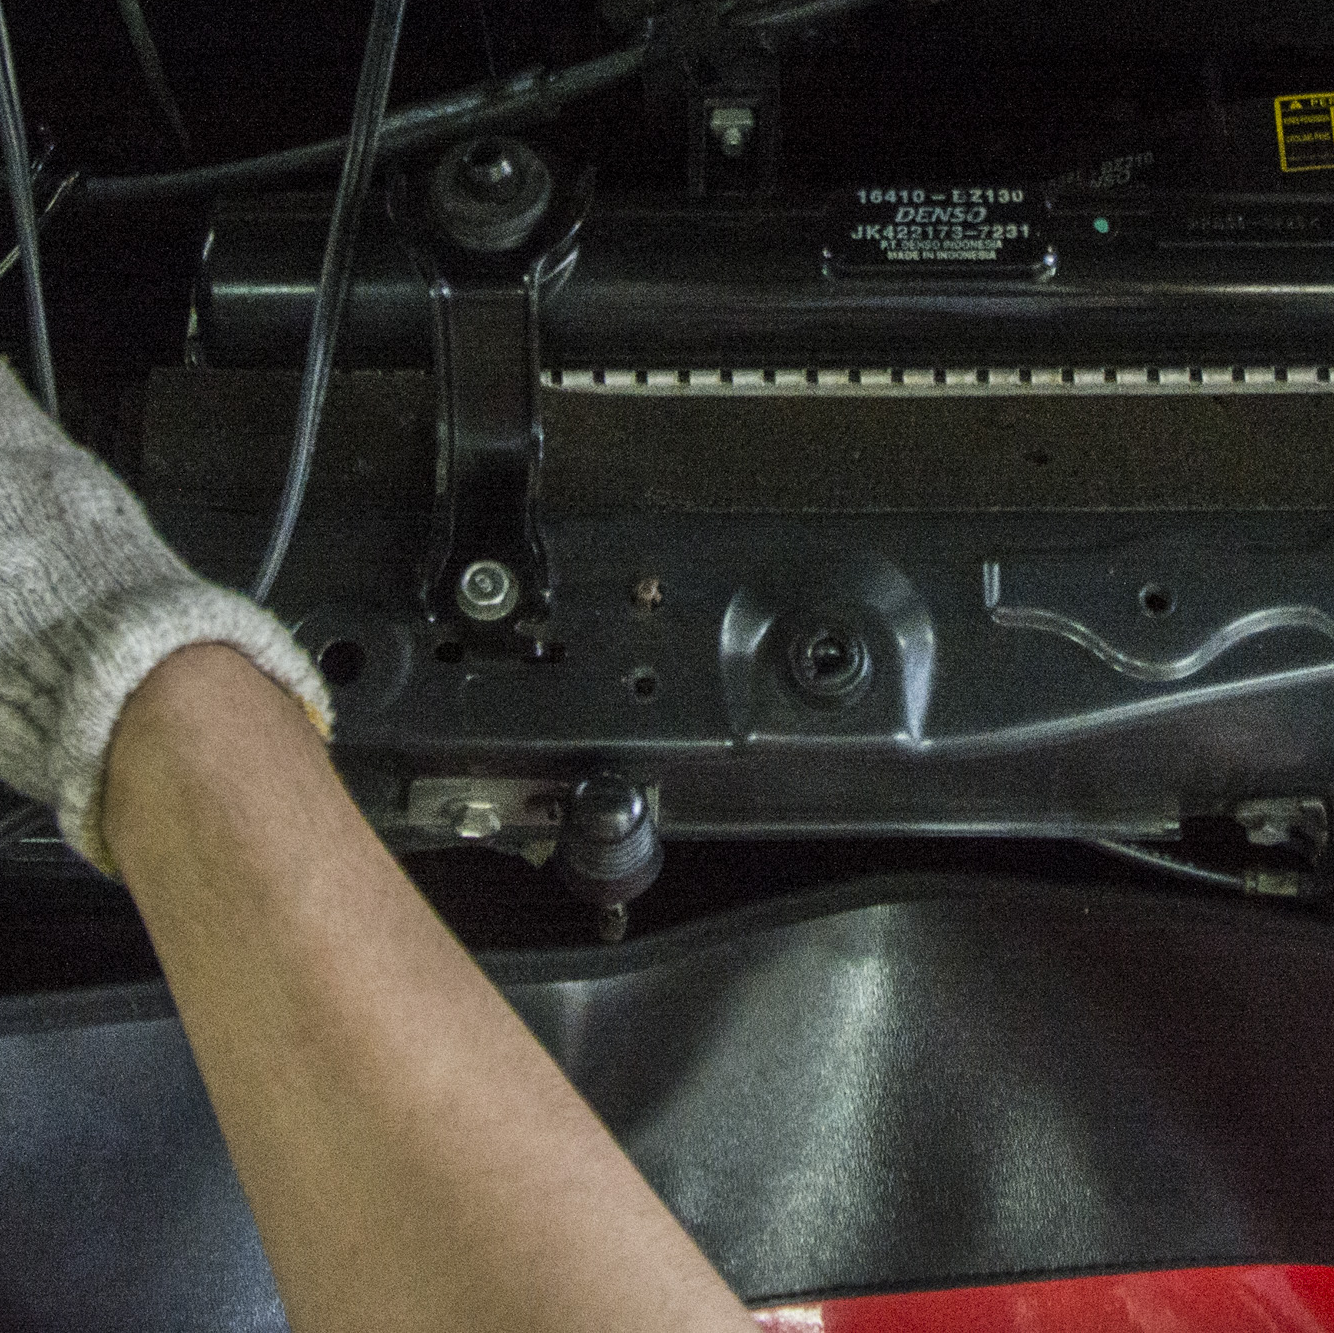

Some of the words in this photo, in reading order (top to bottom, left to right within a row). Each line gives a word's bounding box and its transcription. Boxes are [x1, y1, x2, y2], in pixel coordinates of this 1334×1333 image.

[895, 207, 987, 223] DENSO
[887, 251, 920, 261] MADE
[922, 251, 935, 260] IN
[936, 251, 997, 260] INDONESIA
